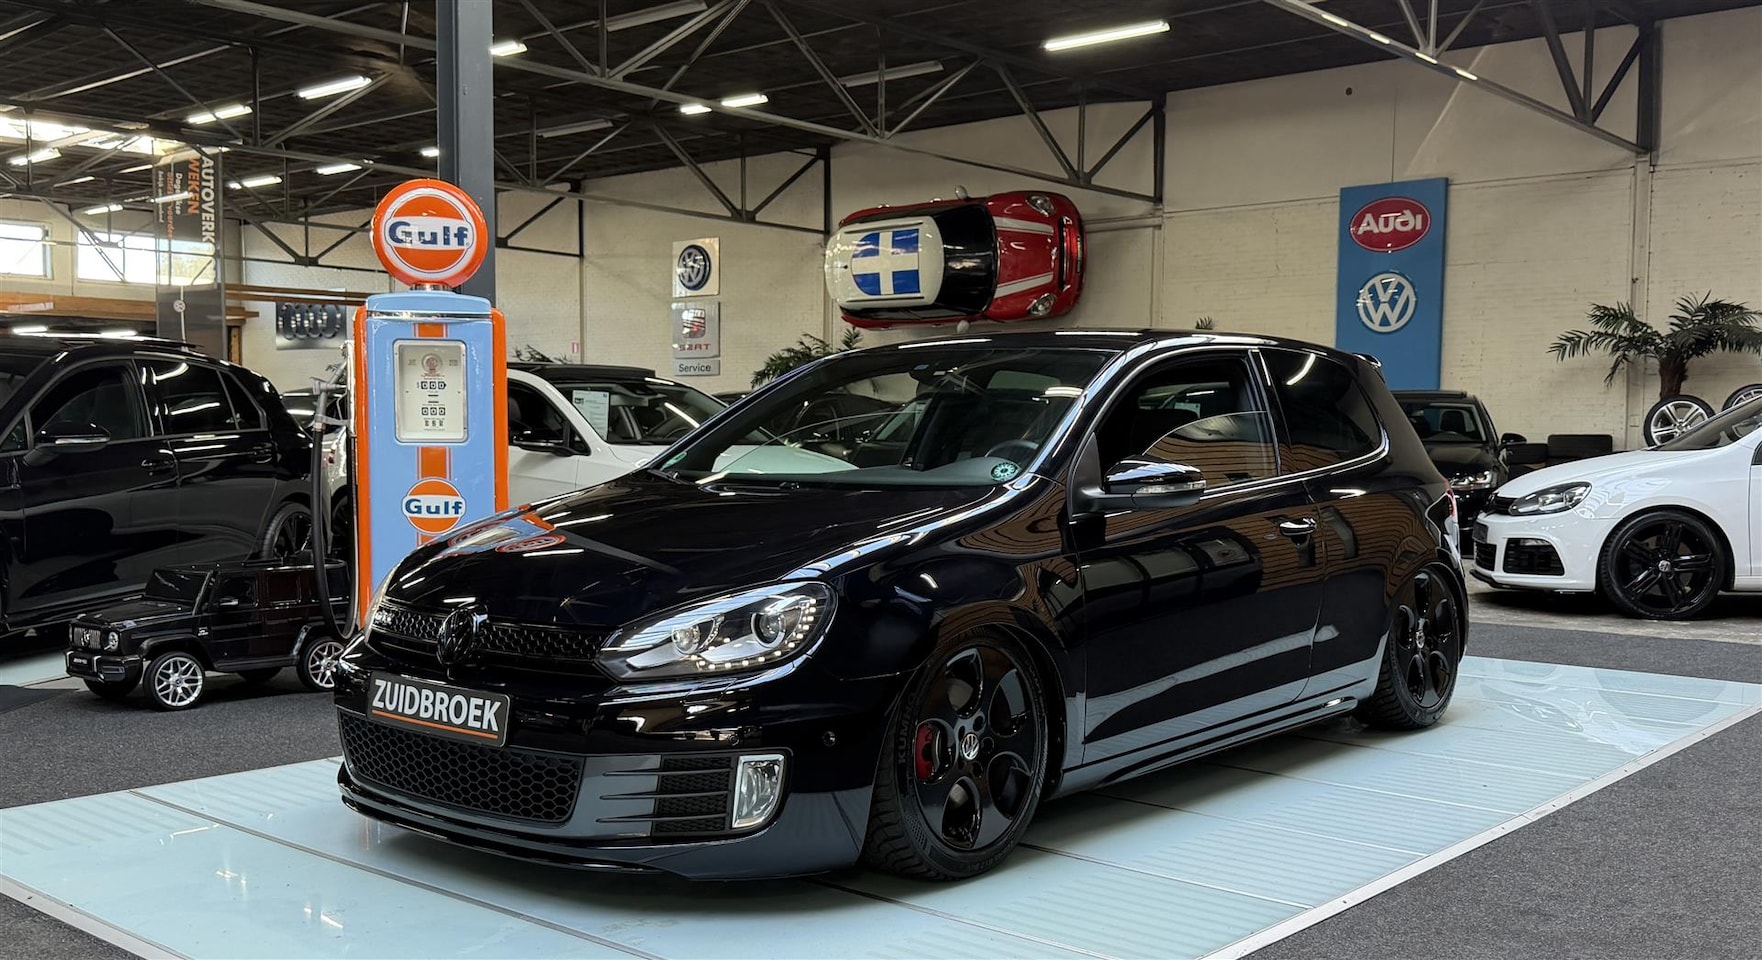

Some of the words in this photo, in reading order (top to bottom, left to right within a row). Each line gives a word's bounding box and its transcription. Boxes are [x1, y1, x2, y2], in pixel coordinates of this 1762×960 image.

[388, 221, 468, 247] Gulf
[678, 363, 711, 373] Service
[405, 499, 463, 515] Gulf
[372, 679, 501, 732] ZUIDBROEK
